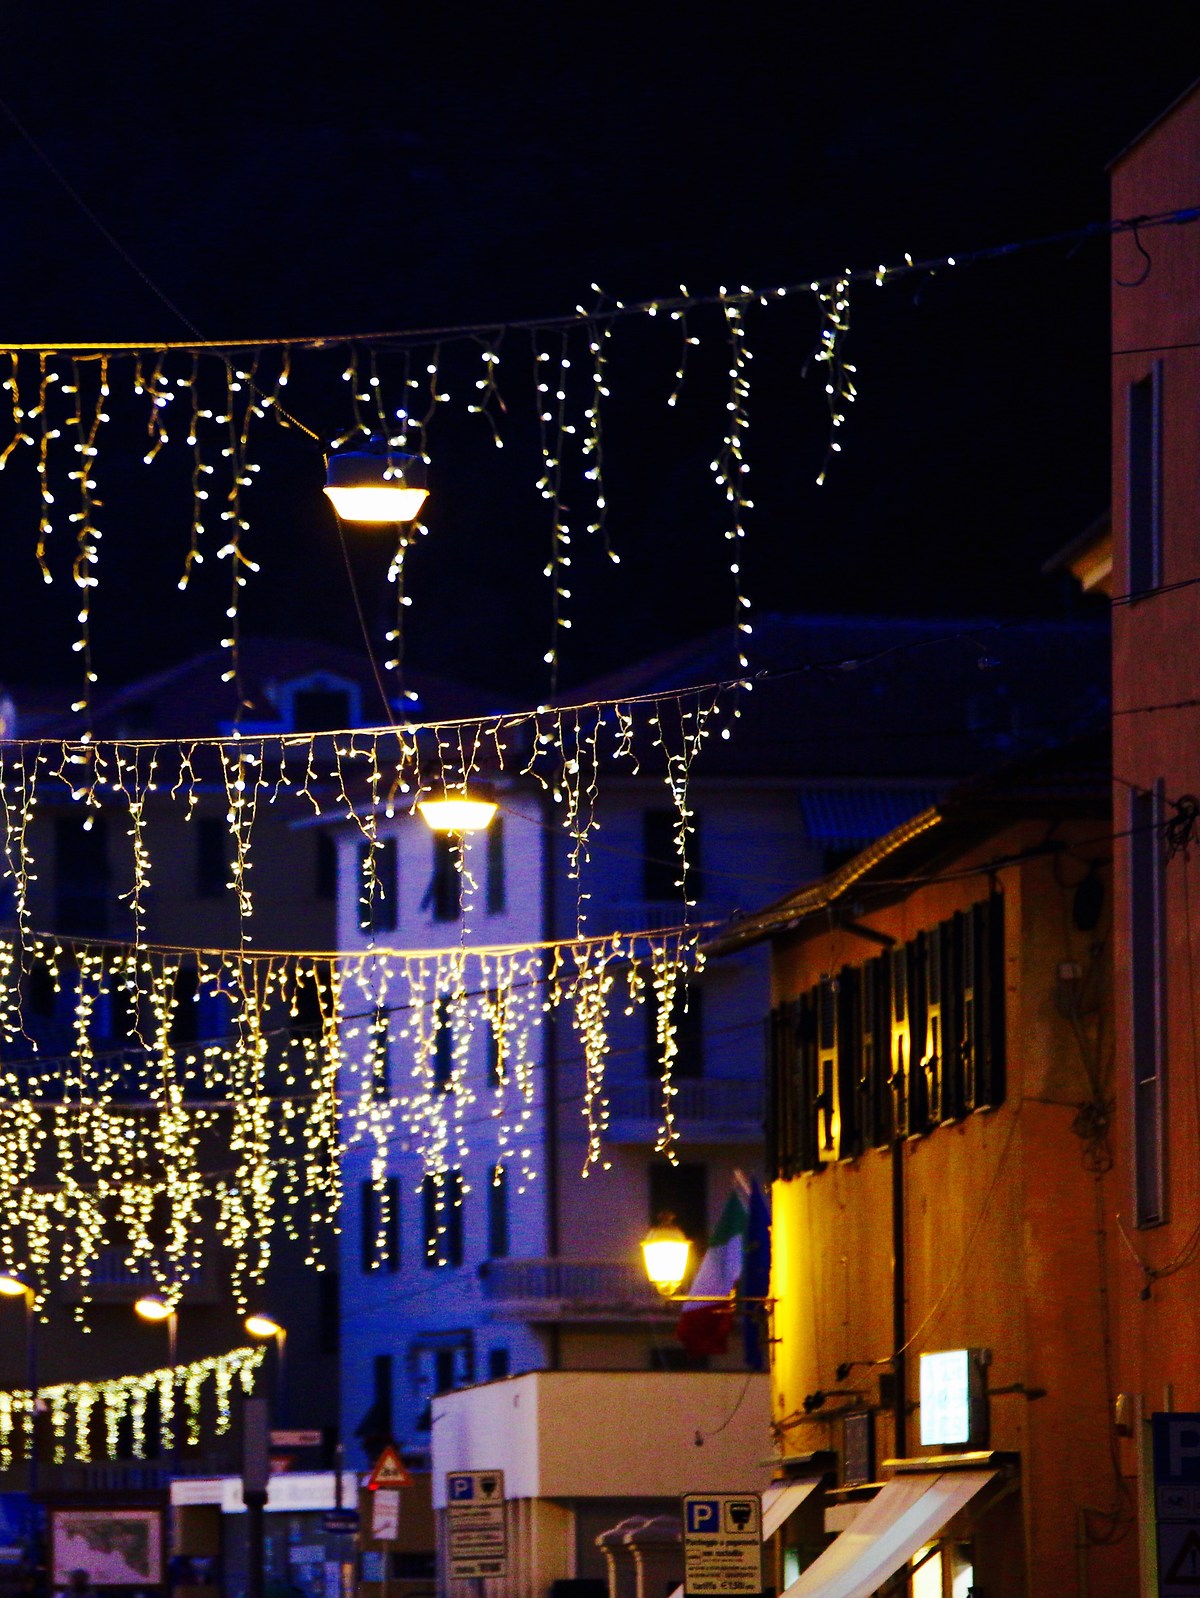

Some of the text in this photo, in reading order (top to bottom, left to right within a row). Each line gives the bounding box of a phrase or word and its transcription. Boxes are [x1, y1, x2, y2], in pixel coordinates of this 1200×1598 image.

[1169, 1421, 1200, 1477] P
[454, 1480, 468, 1498] P
[693, 1504, 712, 1530] P
